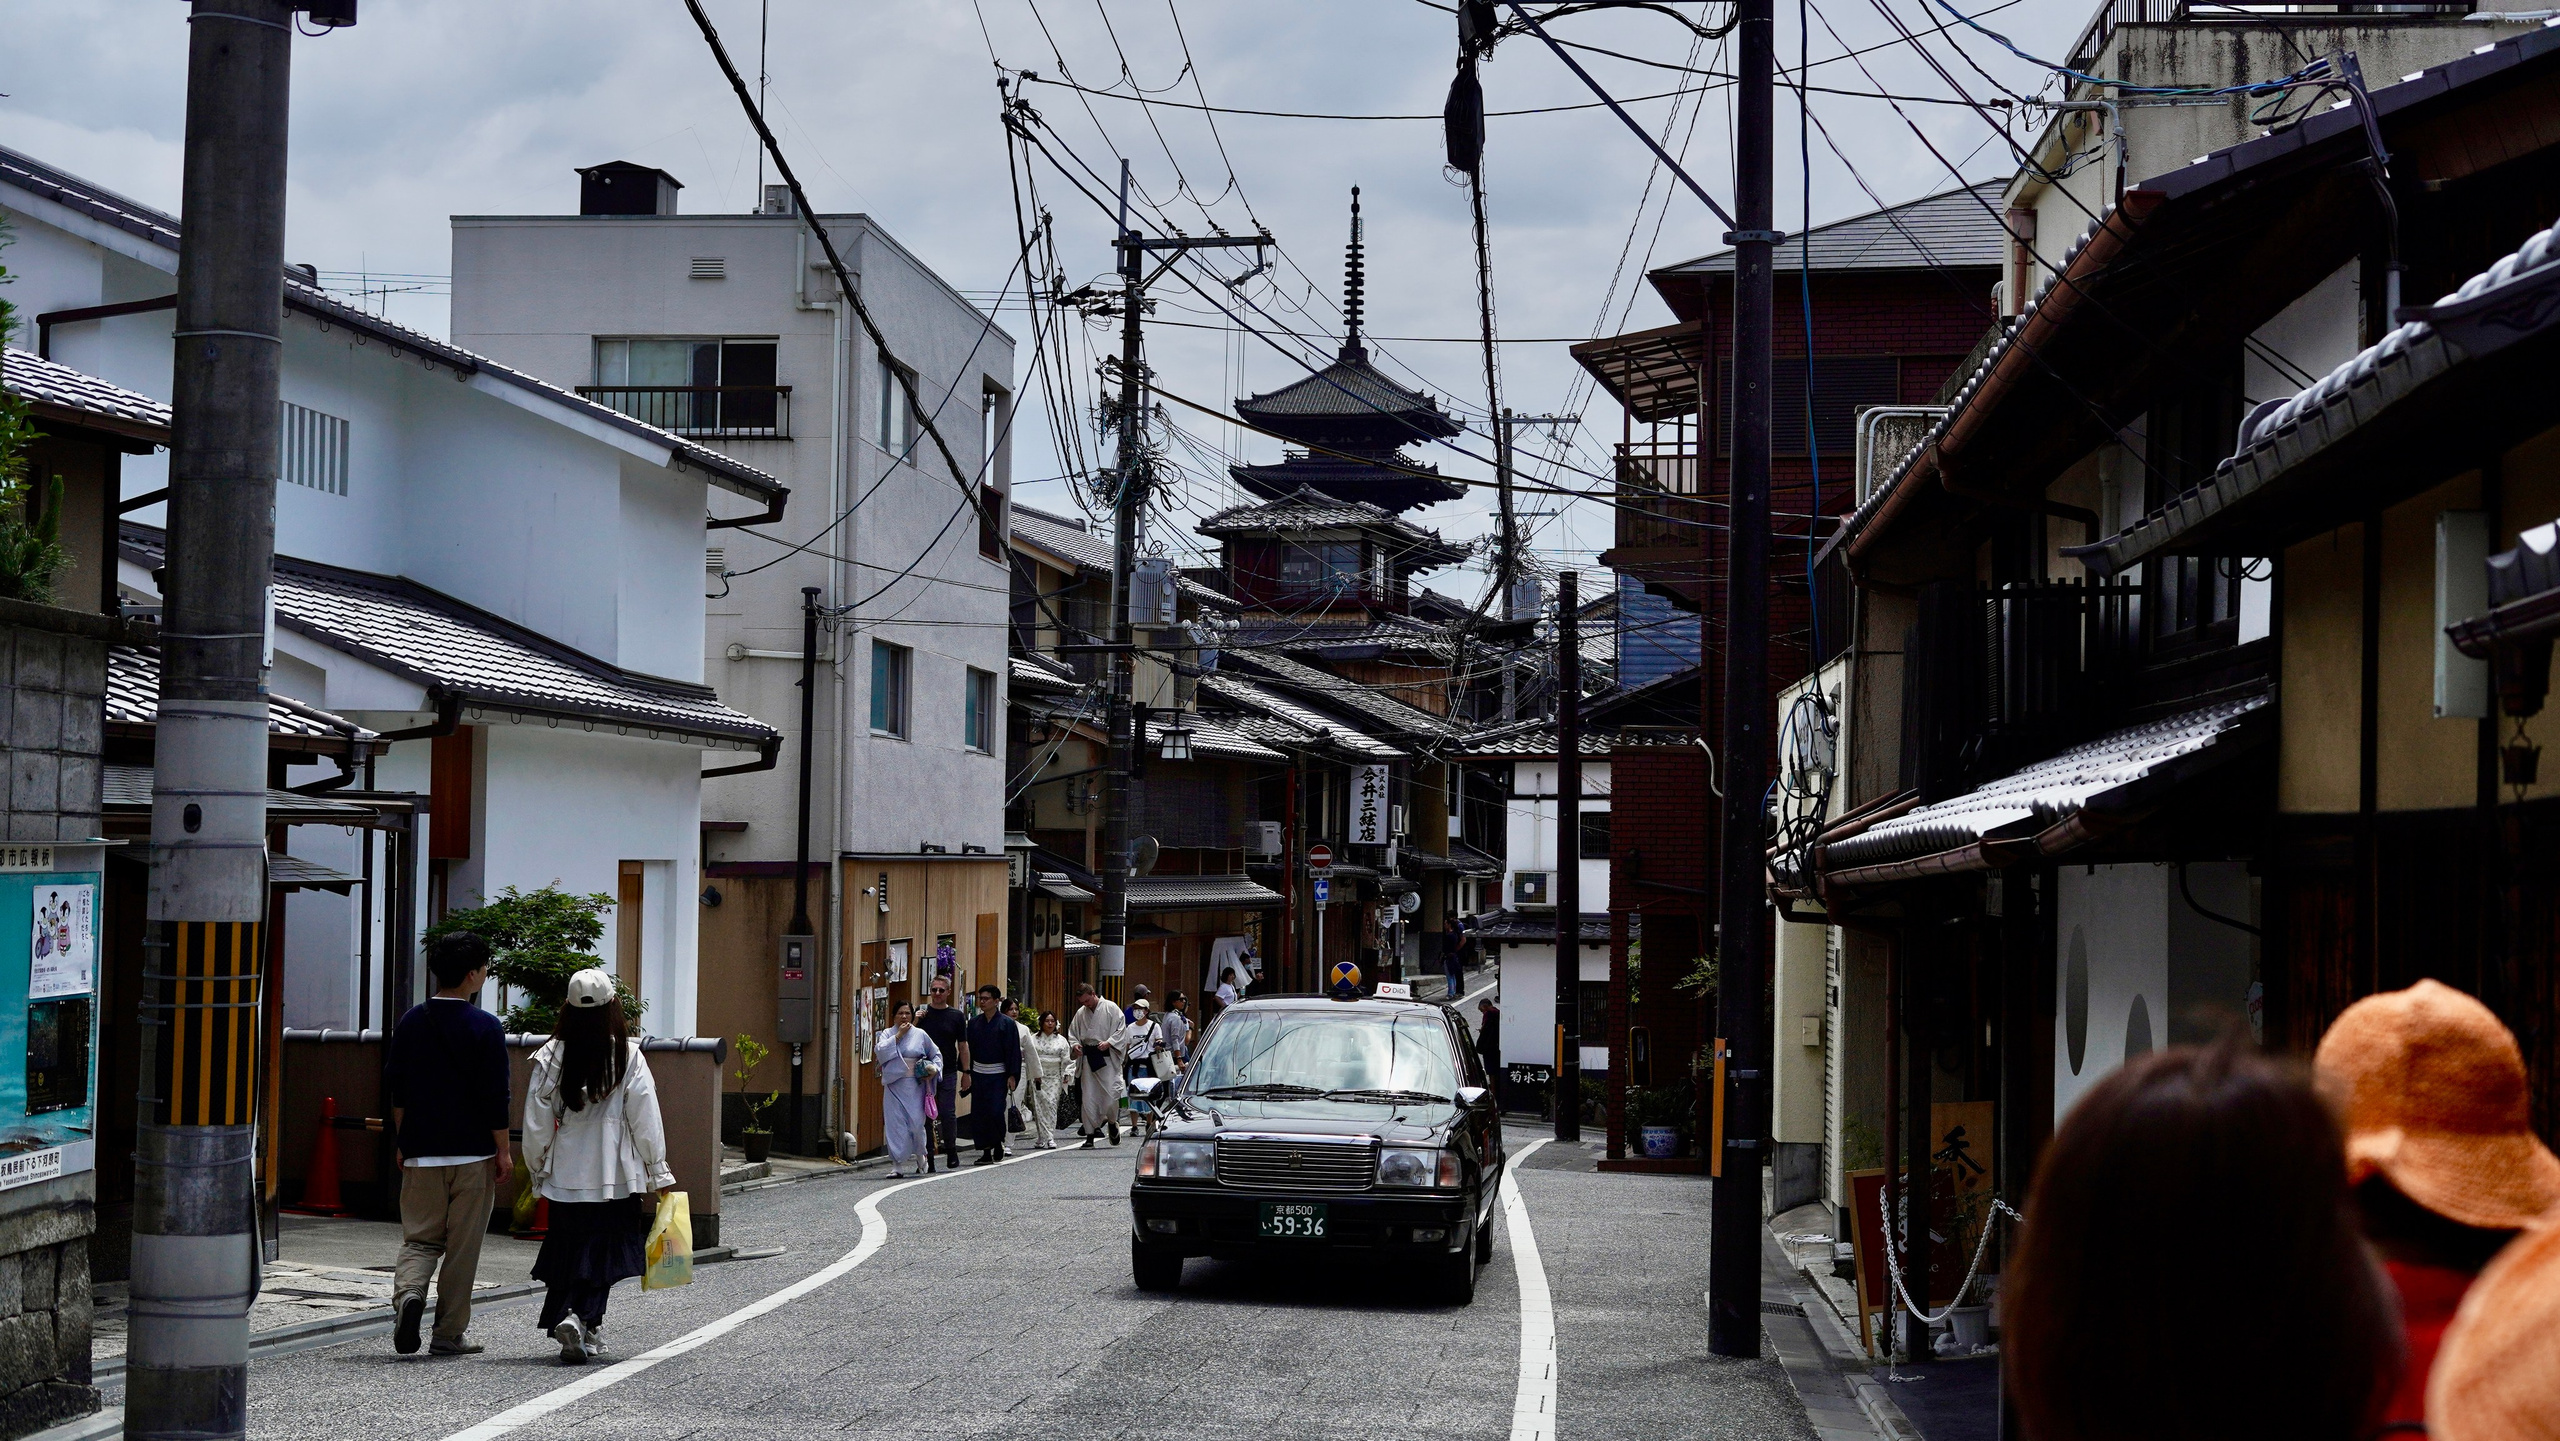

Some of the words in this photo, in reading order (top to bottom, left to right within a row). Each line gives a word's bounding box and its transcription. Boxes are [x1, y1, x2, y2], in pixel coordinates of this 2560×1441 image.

[1359, 767, 1378, 842] 今井三絃店
[1510, 1070, 1536, 1084] 菊水
